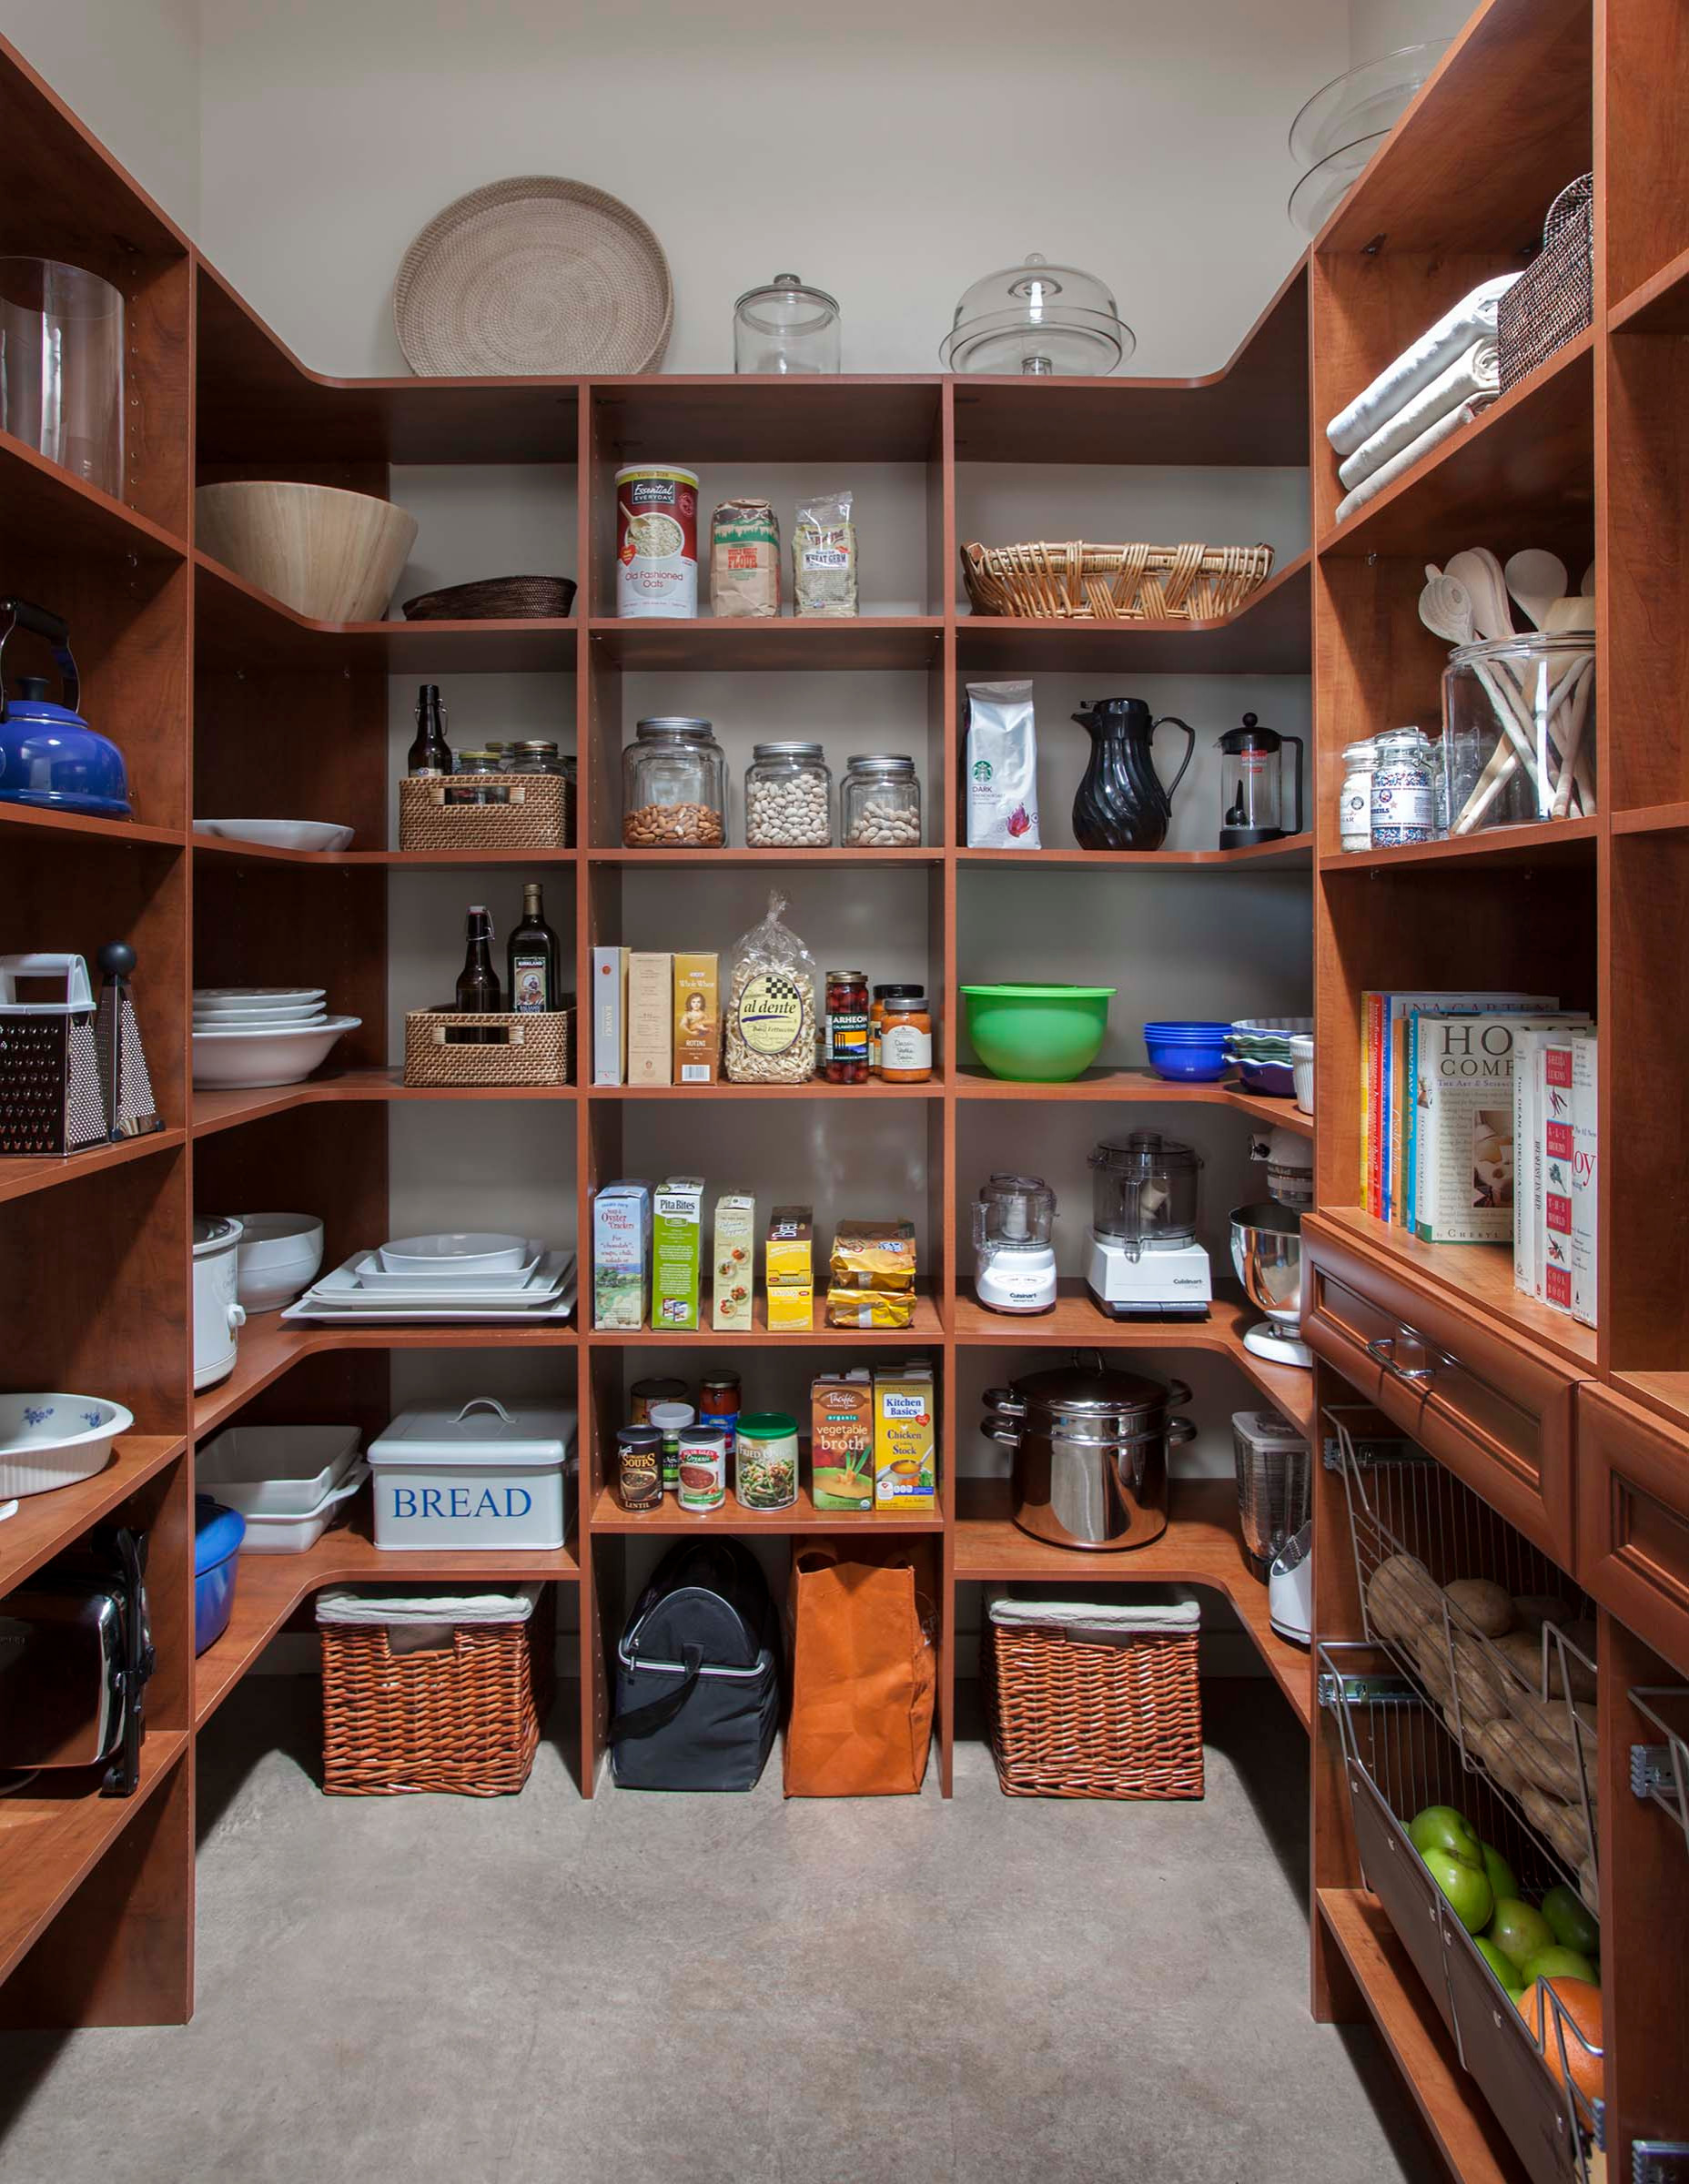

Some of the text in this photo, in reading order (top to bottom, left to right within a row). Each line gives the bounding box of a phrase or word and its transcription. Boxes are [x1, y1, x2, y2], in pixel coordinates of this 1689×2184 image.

[634, 484, 673, 496] Essential
[728, 555, 757, 568] FLOUR
[828, 553, 846, 563] GERM
[625, 571, 683, 581] Old Fashioned
[643, 580, 663, 588] Oats
[743, 1000, 796, 1014] al dente
[1572, 1151, 1596, 1187] oy
[660, 1200, 695, 1210] Pita Bites
[602, 1212, 627, 1222] Oyster
[1548, 1213, 1565, 1227] WORLD
[1548, 1270, 1566, 1285] COOK
[1548, 1287, 1566, 1301] BOOK
[825, 1392, 855, 1405] Pacific
[886, 1399, 922, 1407] Kitchen
[891, 1407, 918, 1416] Basics
[816, 1425, 867, 1437] vegetable
[887, 1430, 922, 1440] Chicken
[821, 1436, 865, 1451] broth
[893, 1444, 917, 1455] Stock
[622, 1453, 654, 1467] SOUPS
[392, 1488, 531, 1518] BREAD
